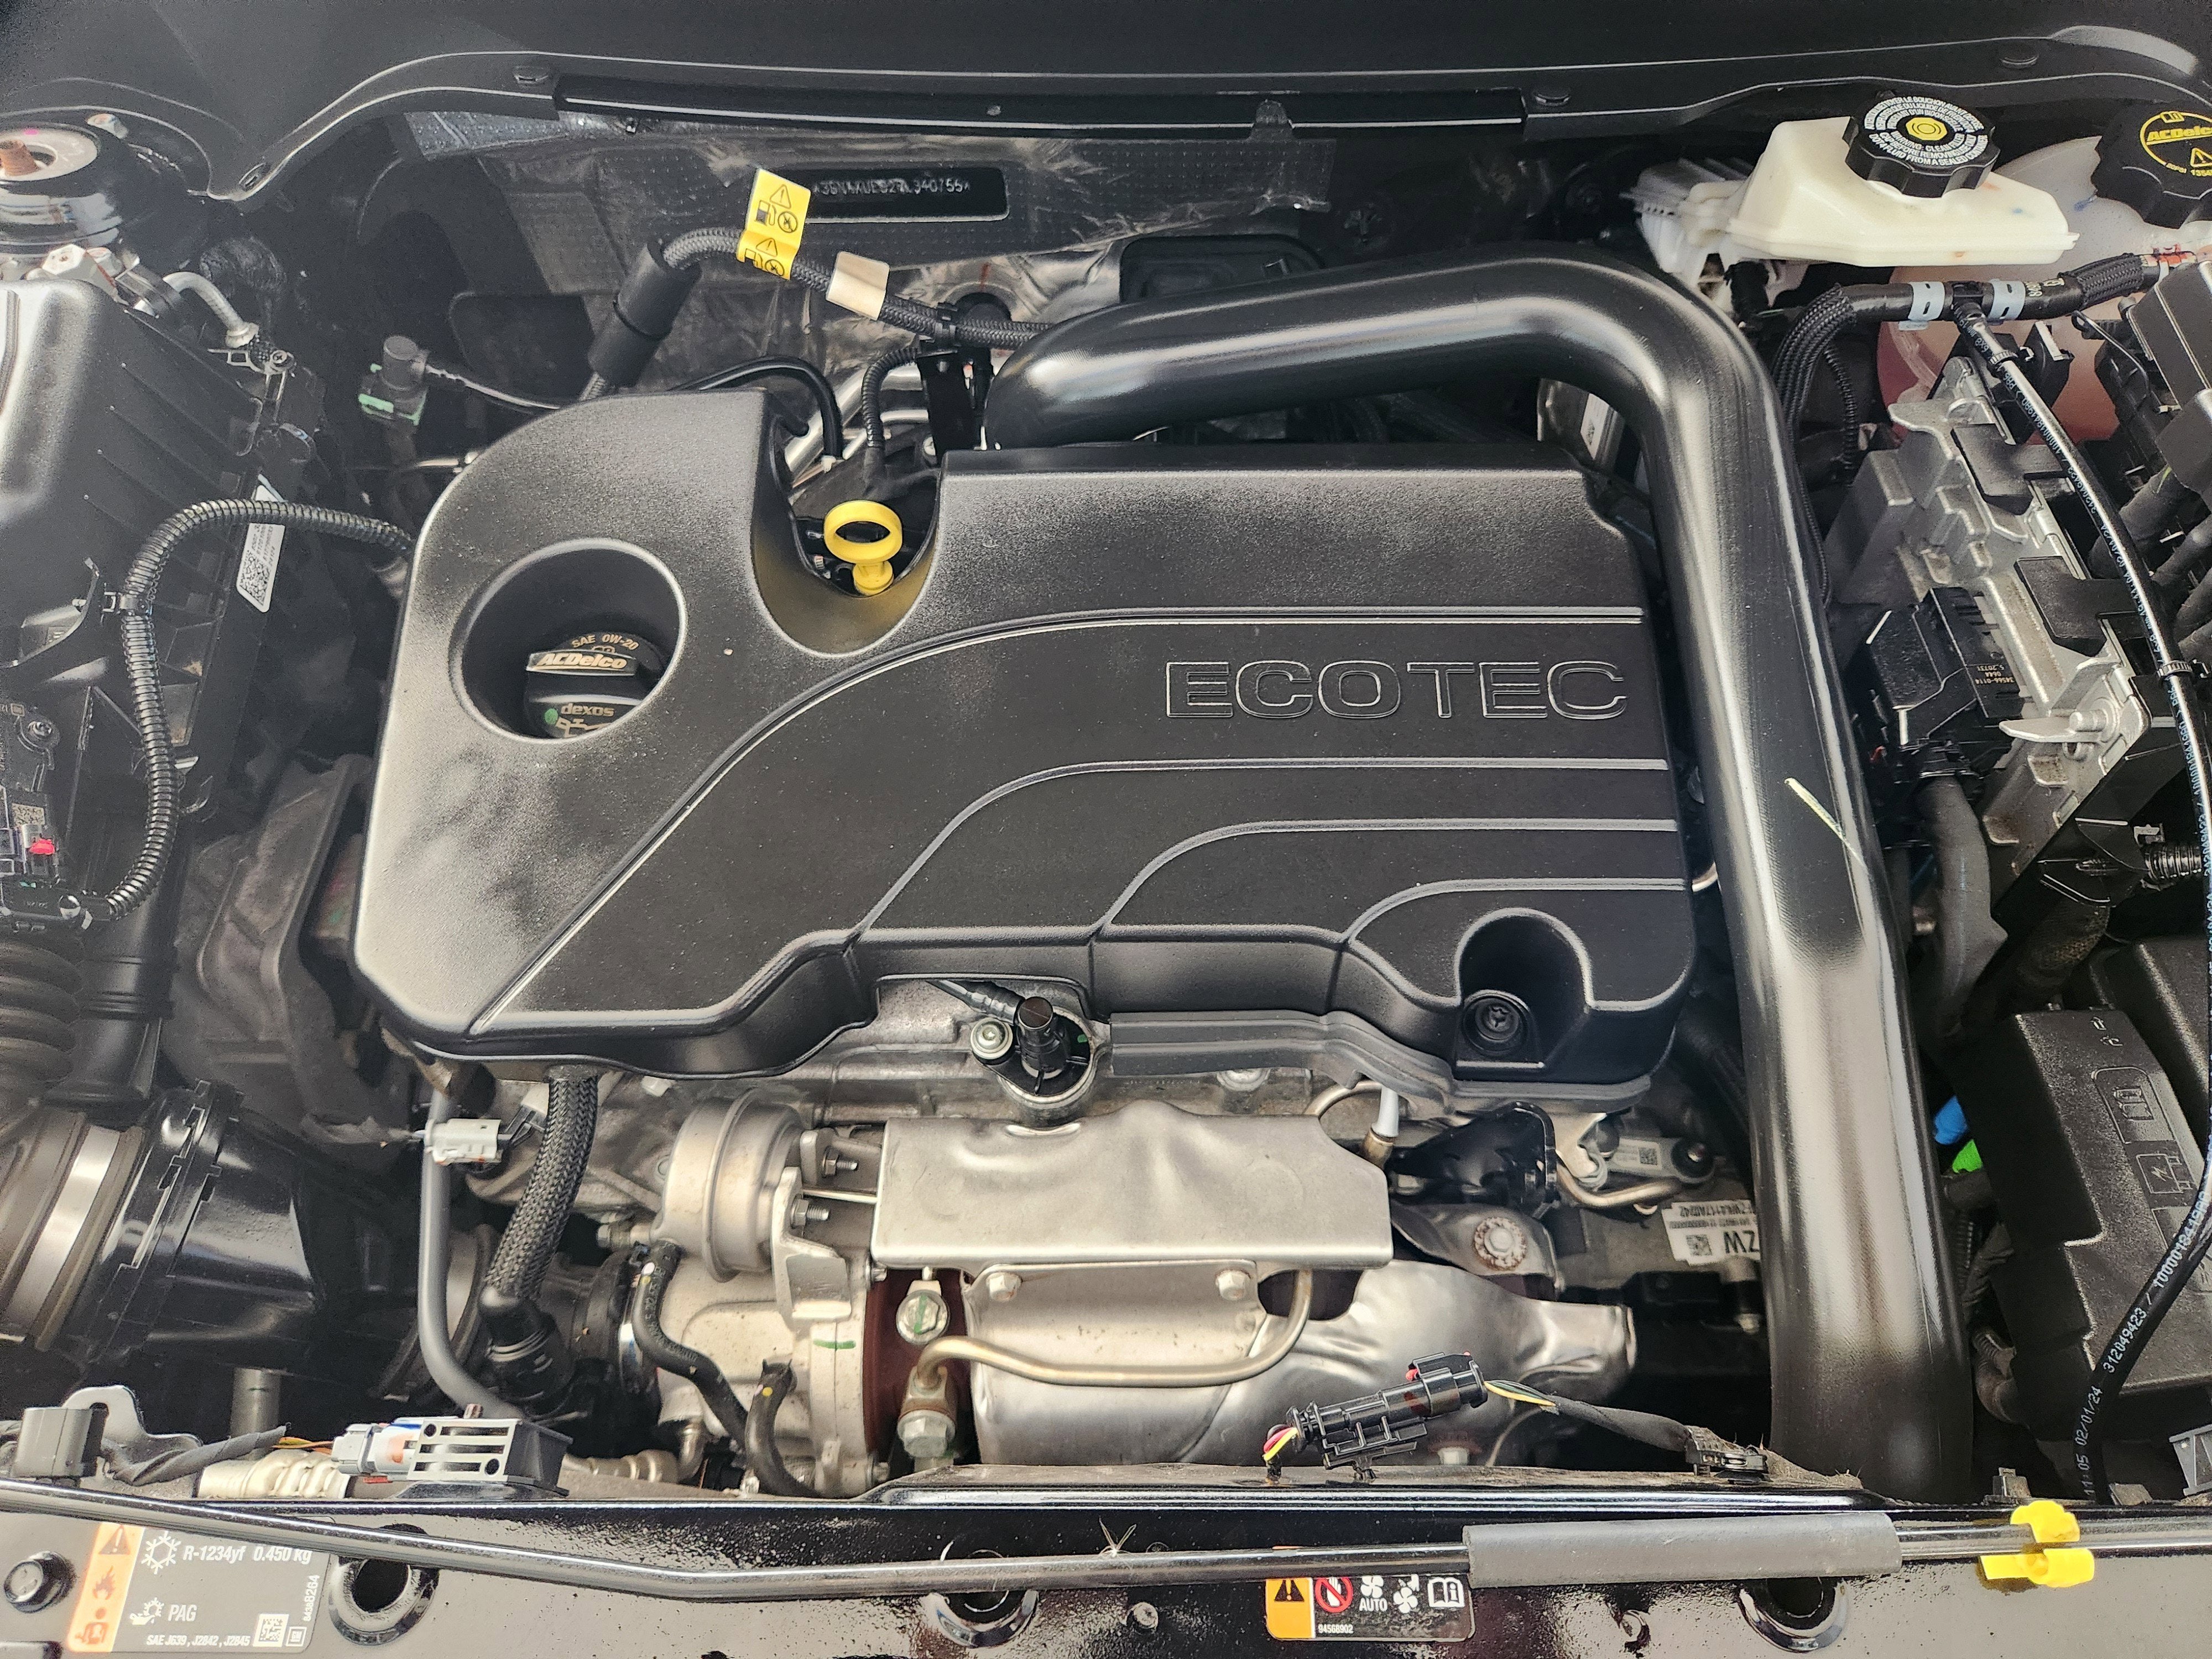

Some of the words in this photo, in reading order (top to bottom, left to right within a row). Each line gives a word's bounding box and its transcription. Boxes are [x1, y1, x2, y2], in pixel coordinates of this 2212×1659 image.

[1912, 96, 1947, 106] BOUCHON
[1943, 101, 1970, 115] AVANT
[1912, 102, 1938, 111] LIQUIDE
[1936, 106, 1949, 114] DE
[1880, 132, 1895, 142] CAP
[1890, 140, 1920, 156] BEFORE
[1883, 145, 1907, 159] FLUID
[1906, 154, 1931, 165] FROM
[1938, 155, 1969, 165] SEALED
[1965, 135, 1988, 160] CONTAINER
[571, 635, 596, 648] SAE
[602, 634, 639, 651] 0W-20
[536, 653, 628, 669] ACDelco
[1166, 660, 1627, 719] ECOTEC
[560, 703, 615, 717] dexos
[2103, 1307, 2148, 1374] 312049423
[2074, 1385, 2103, 1446] 02/01/24
[183, 1546, 247, 1563] R-1234yf
[253, 1546, 292, 1561] 0.450
[293, 1548, 313, 1564] kg
[303, 1575, 320, 1621] 84388264
[1359, 1598, 1388, 1612] AUTO
[168, 1605, 197, 1621] PAG
[1318, 1624, 1354, 1634] 94568902
[147, 1635, 163, 1646] SAE
[223, 1635, 251, 1646] J2845
